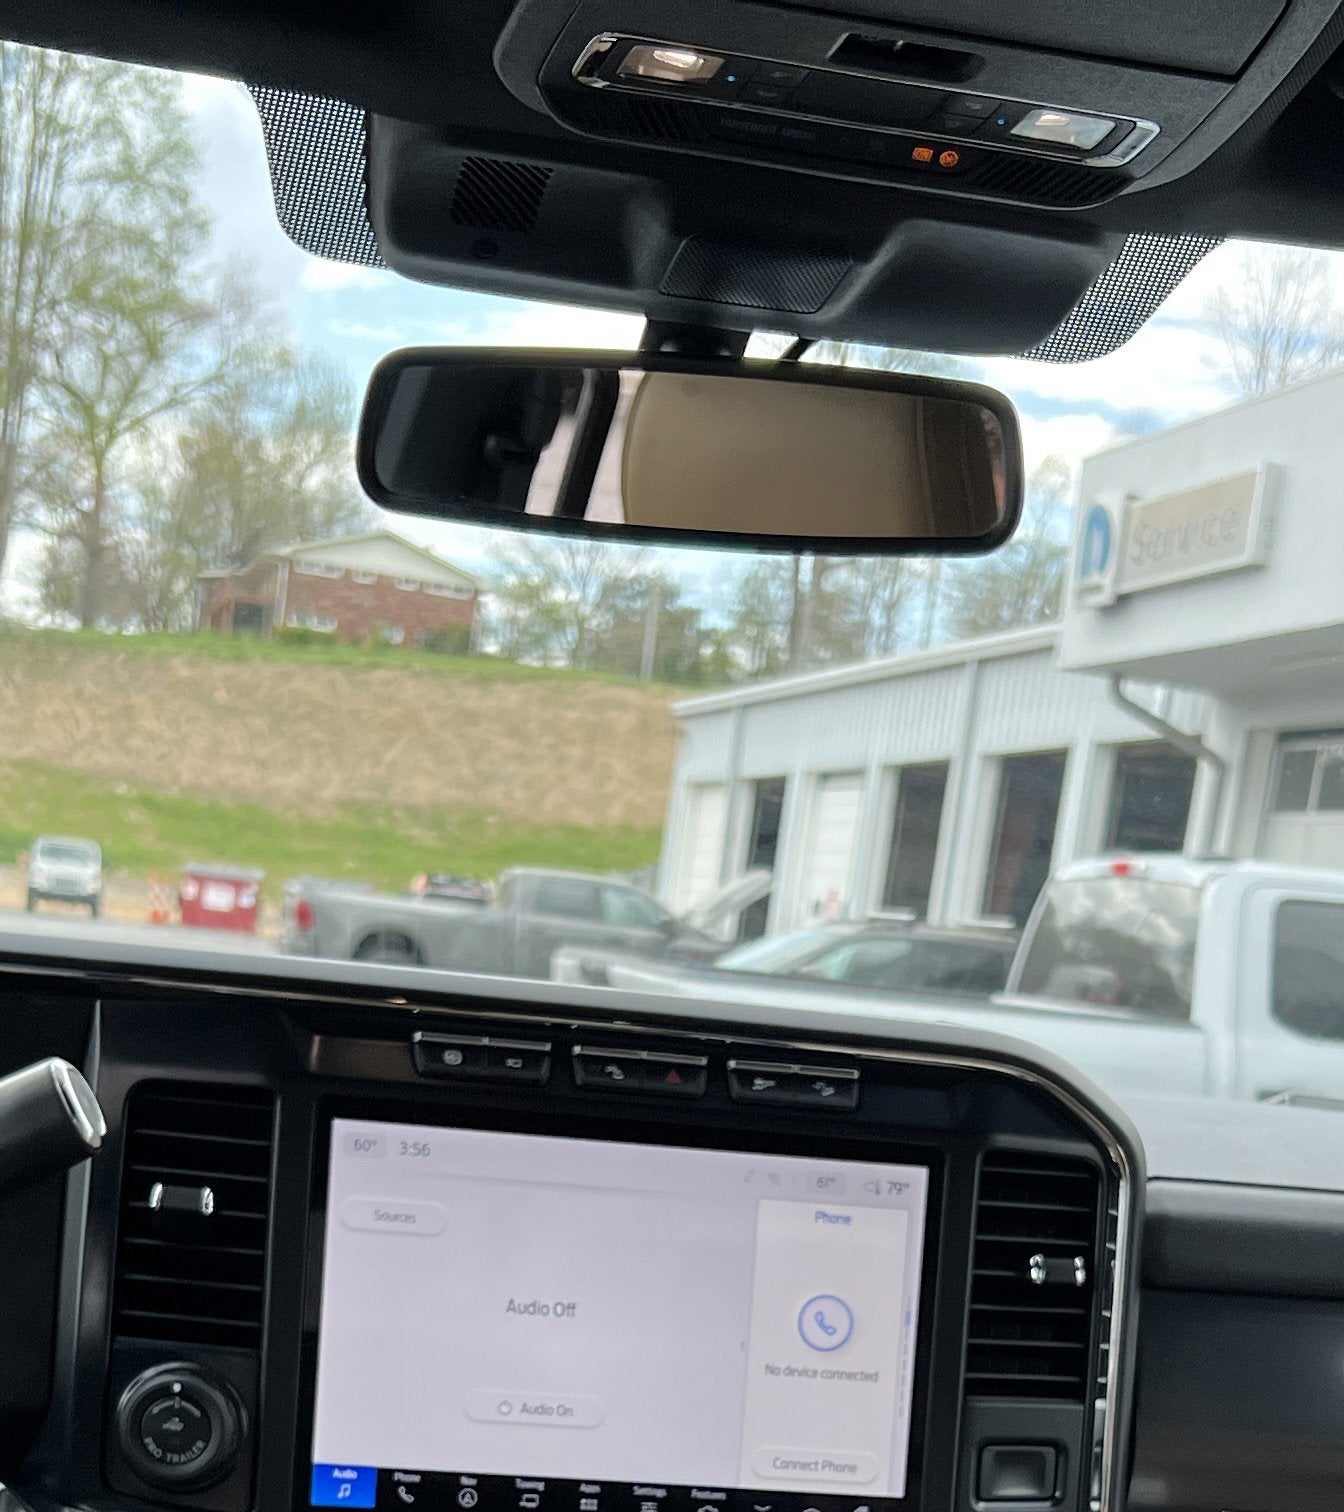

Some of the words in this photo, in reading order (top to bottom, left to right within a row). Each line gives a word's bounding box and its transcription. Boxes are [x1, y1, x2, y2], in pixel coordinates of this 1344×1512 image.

[1130, 507, 1240, 566] Service
[399, 1140, 432, 1157] 3:56
[373, 1208, 417, 1224] Sources
[814, 1210, 852, 1226] Phone
[506, 1298, 551, 1317] Audio
[552, 1301, 578, 1318] Off
[764, 1363, 781, 1377] No
[782, 1365, 819, 1379] device
[820, 1369, 879, 1384] connected
[520, 1402, 555, 1417] Audio
[555, 1403, 574, 1418] On
[166, 1439, 205, 1464] TRAILER
[772, 1456, 819, 1472] Connect
[820, 1460, 859, 1474] Phone
